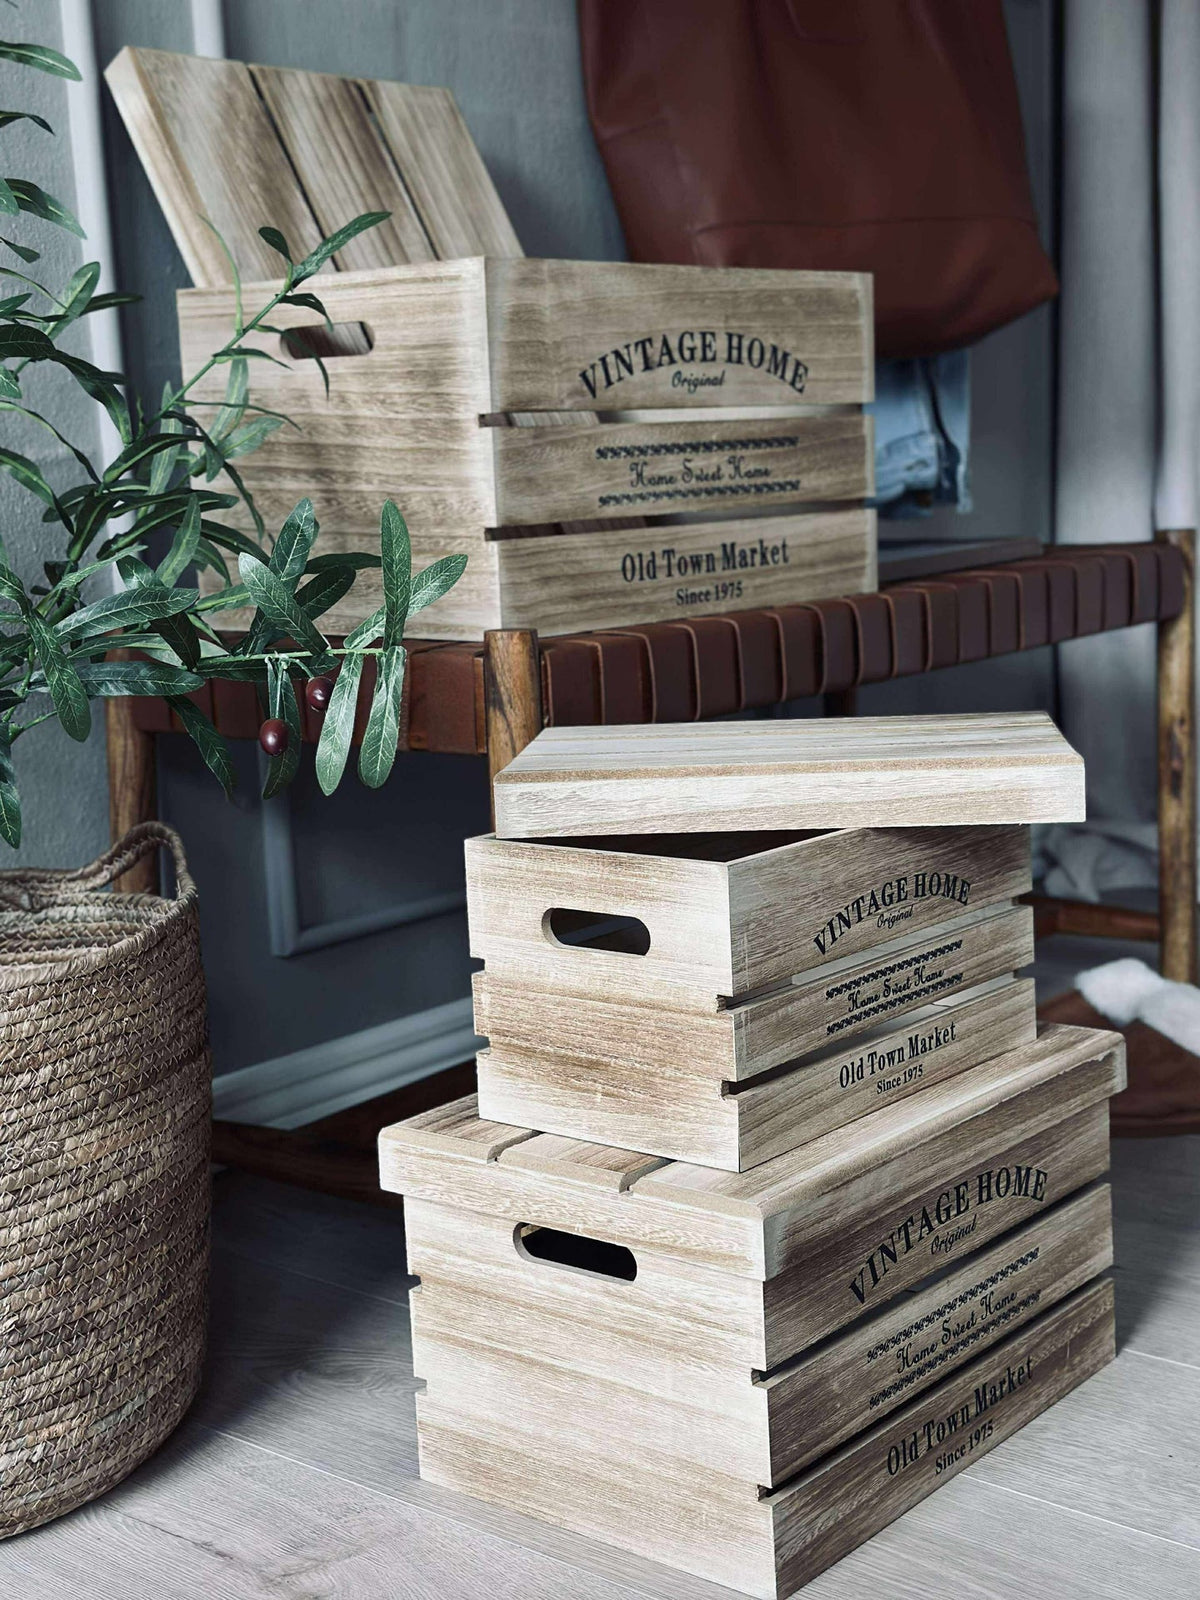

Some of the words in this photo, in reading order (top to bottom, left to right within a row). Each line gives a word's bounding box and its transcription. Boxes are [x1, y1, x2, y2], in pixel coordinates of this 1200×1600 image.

[579, 331, 717, 399] VINTAGE
[725, 332, 809, 394] HOME
[671, 370, 725, 394] Original
[629, 461, 677, 488] Home
[682, 457, 724, 484] Sweet
[727, 455, 772, 480] Home
[621, 551, 657, 582] Old
[662, 548, 716, 577] Town
[721, 538, 790, 571] Market
[676, 588, 711, 606] Since
[714, 581, 743, 601] 1975
[813, 877, 908, 956] VINTAGE
[914, 872, 971, 906] HOME
[877, 904, 914, 930] Original
[847, 989, 880, 1012] Home
[883, 977, 912, 998] Sweet
[914, 965, 945, 987] Home
[839, 1058, 864, 1088] Old
[868, 1046, 905, 1076] Town
[908, 1021, 957, 1059] Market
[876, 1079, 901, 1094] Since
[903, 1064, 923, 1084] 1975
[849, 1181, 970, 1304] VINTAGE
[976, 1165, 1048, 1206] HOME
[930, 1213, 978, 1255] Original
[896, 1343, 938, 1374] Home
[941, 1309, 978, 1345] Sweet
[980, 1291, 1018, 1320] Home
[887, 1431, 919, 1476] Old
[923, 1405, 970, 1452] Town
[974, 1355, 1033, 1418] Market
[935, 1445, 966, 1475] Since
[968, 1419, 994, 1451] 1975
